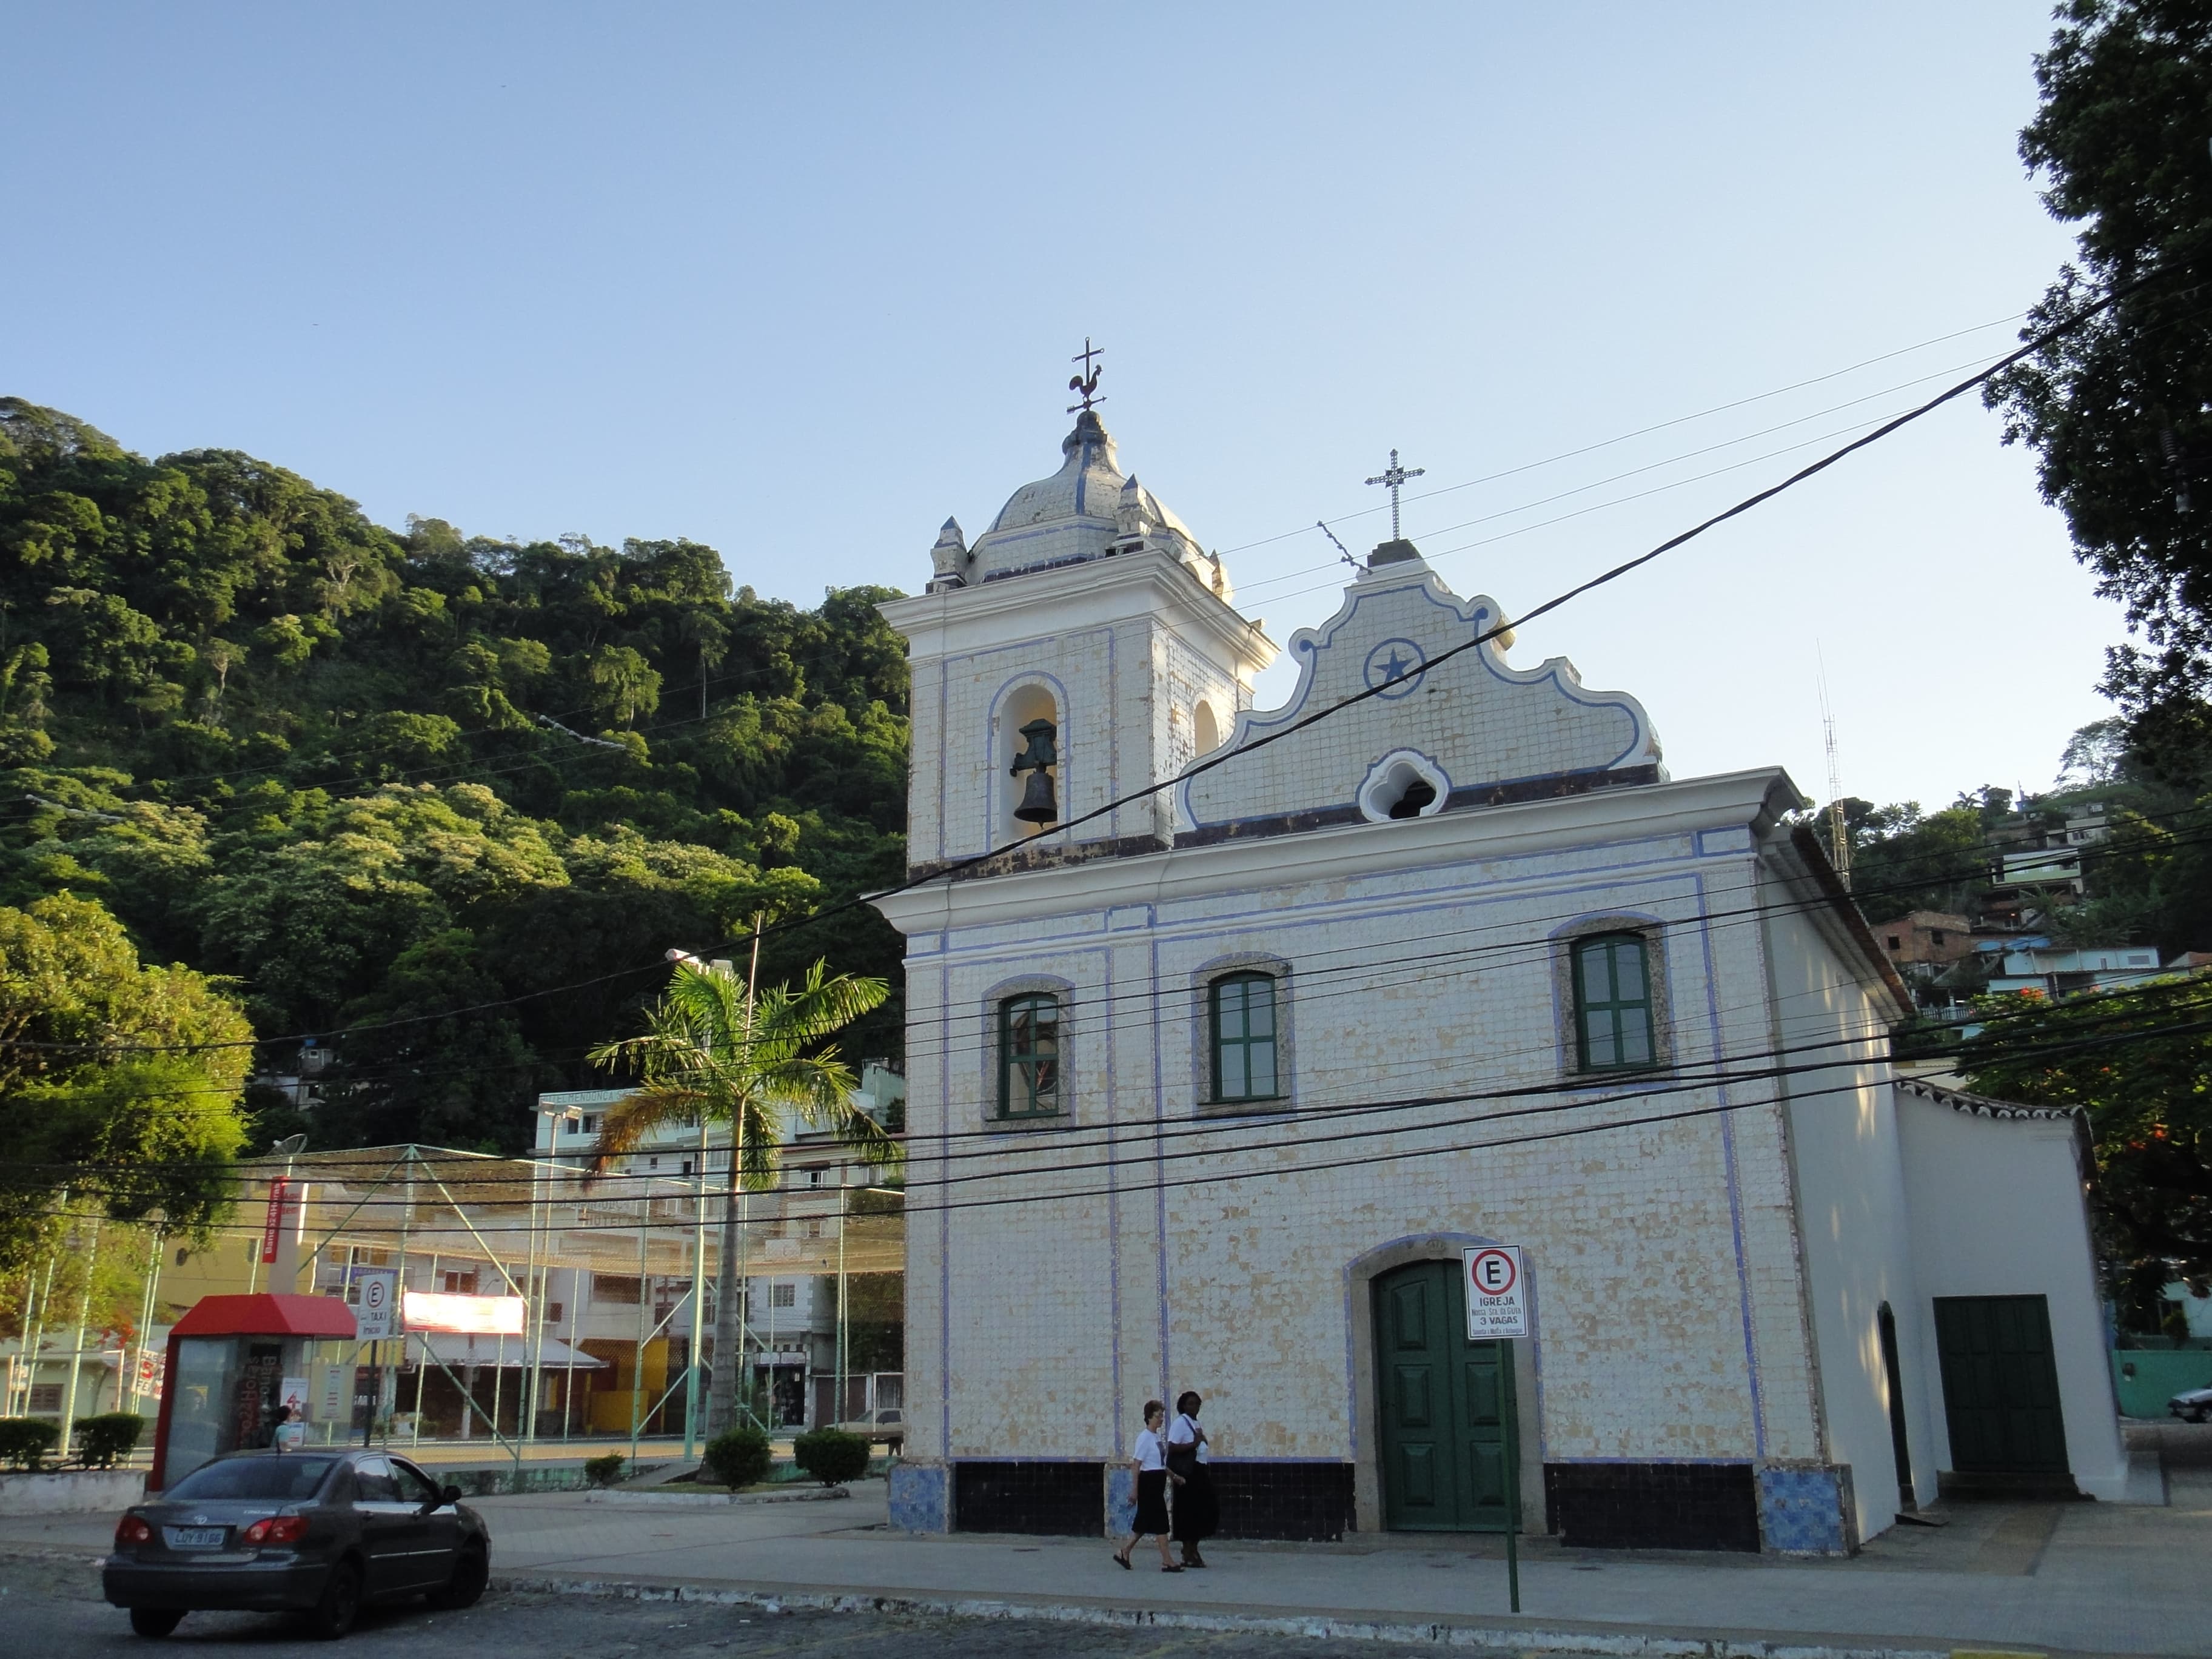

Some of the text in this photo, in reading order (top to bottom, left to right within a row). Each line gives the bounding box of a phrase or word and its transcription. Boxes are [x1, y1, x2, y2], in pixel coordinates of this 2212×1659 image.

[1486, 1260, 1501, 1284] E
[371, 1287, 380, 1302] E
[1480, 1296, 1515, 1307] IGREJA
[371, 1312, 387, 1321] TAXI
[1480, 1316, 1518, 1326] 3 VAGAS
